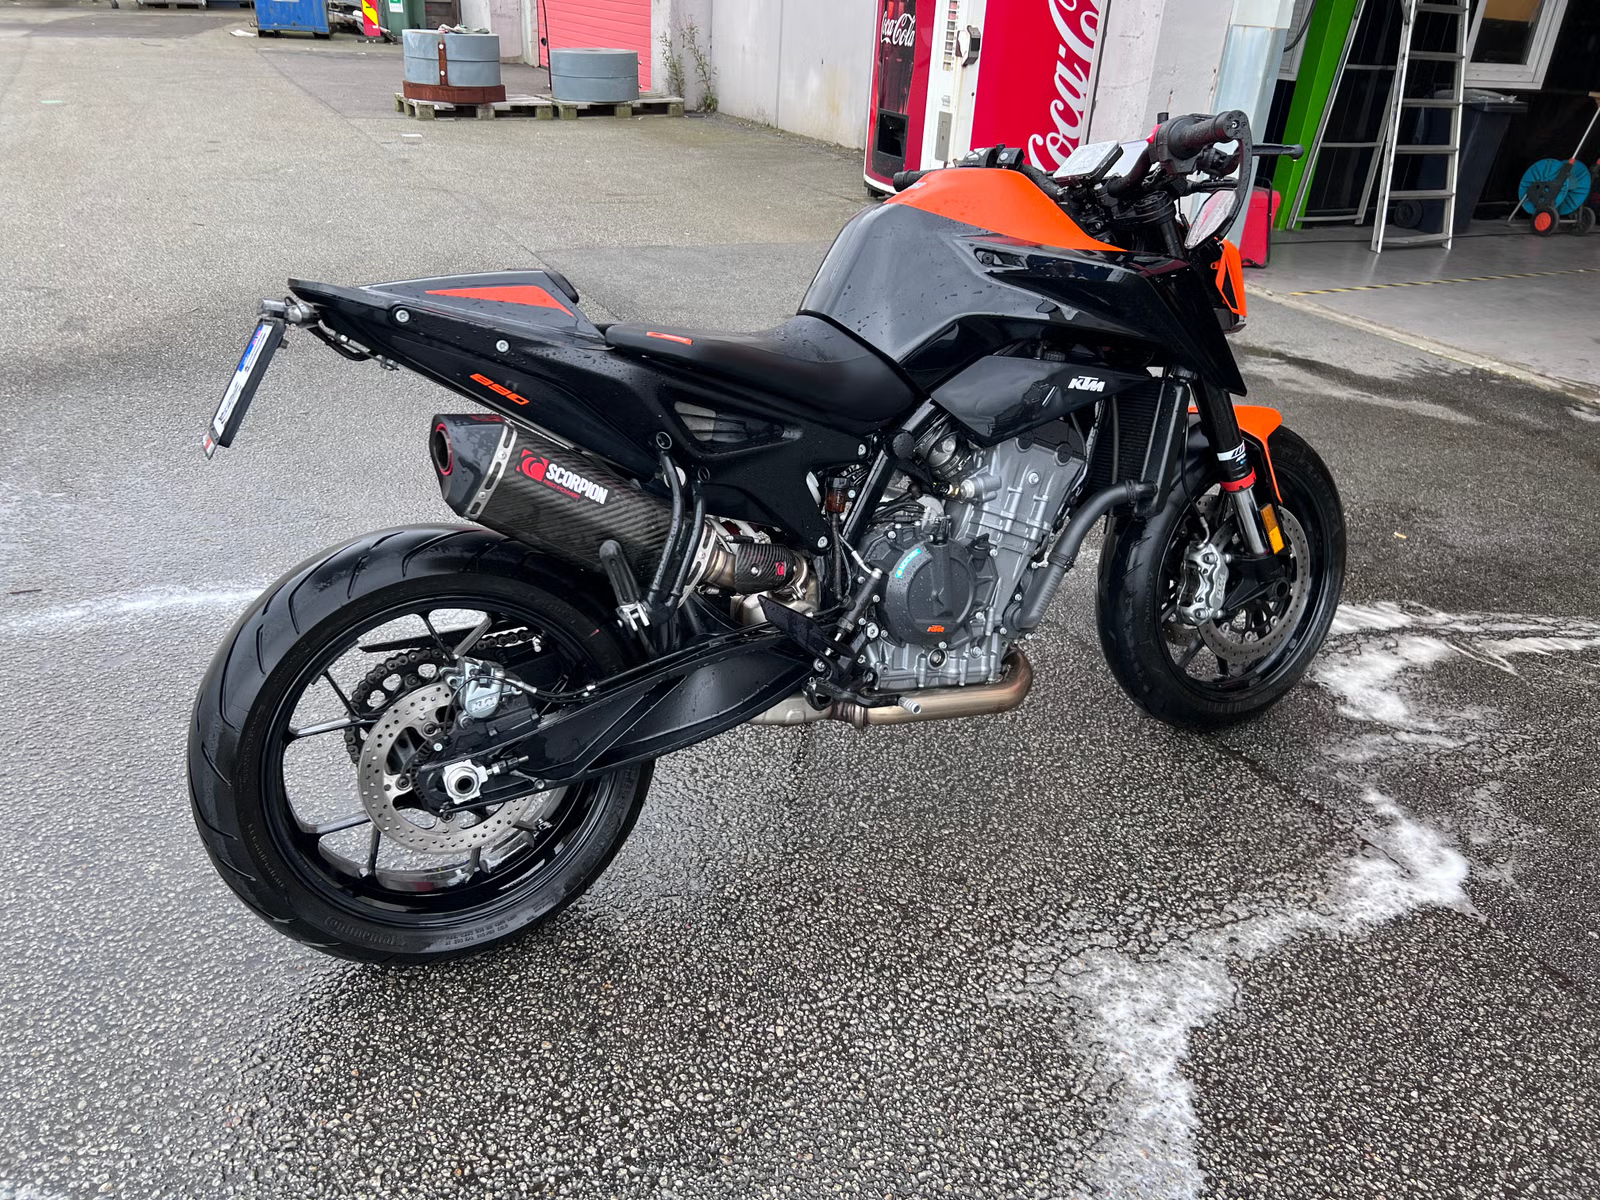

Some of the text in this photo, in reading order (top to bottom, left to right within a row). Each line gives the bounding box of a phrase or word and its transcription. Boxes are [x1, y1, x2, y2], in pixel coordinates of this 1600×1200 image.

[880, 10, 916, 47] Coca-Cola
[469, 373, 531, 406] 890
[1067, 375, 1106, 393] KTM
[545, 463, 609, 505] SCORPION
[927, 625, 945, 633] KTM
[324, 915, 396, 946] Continental
